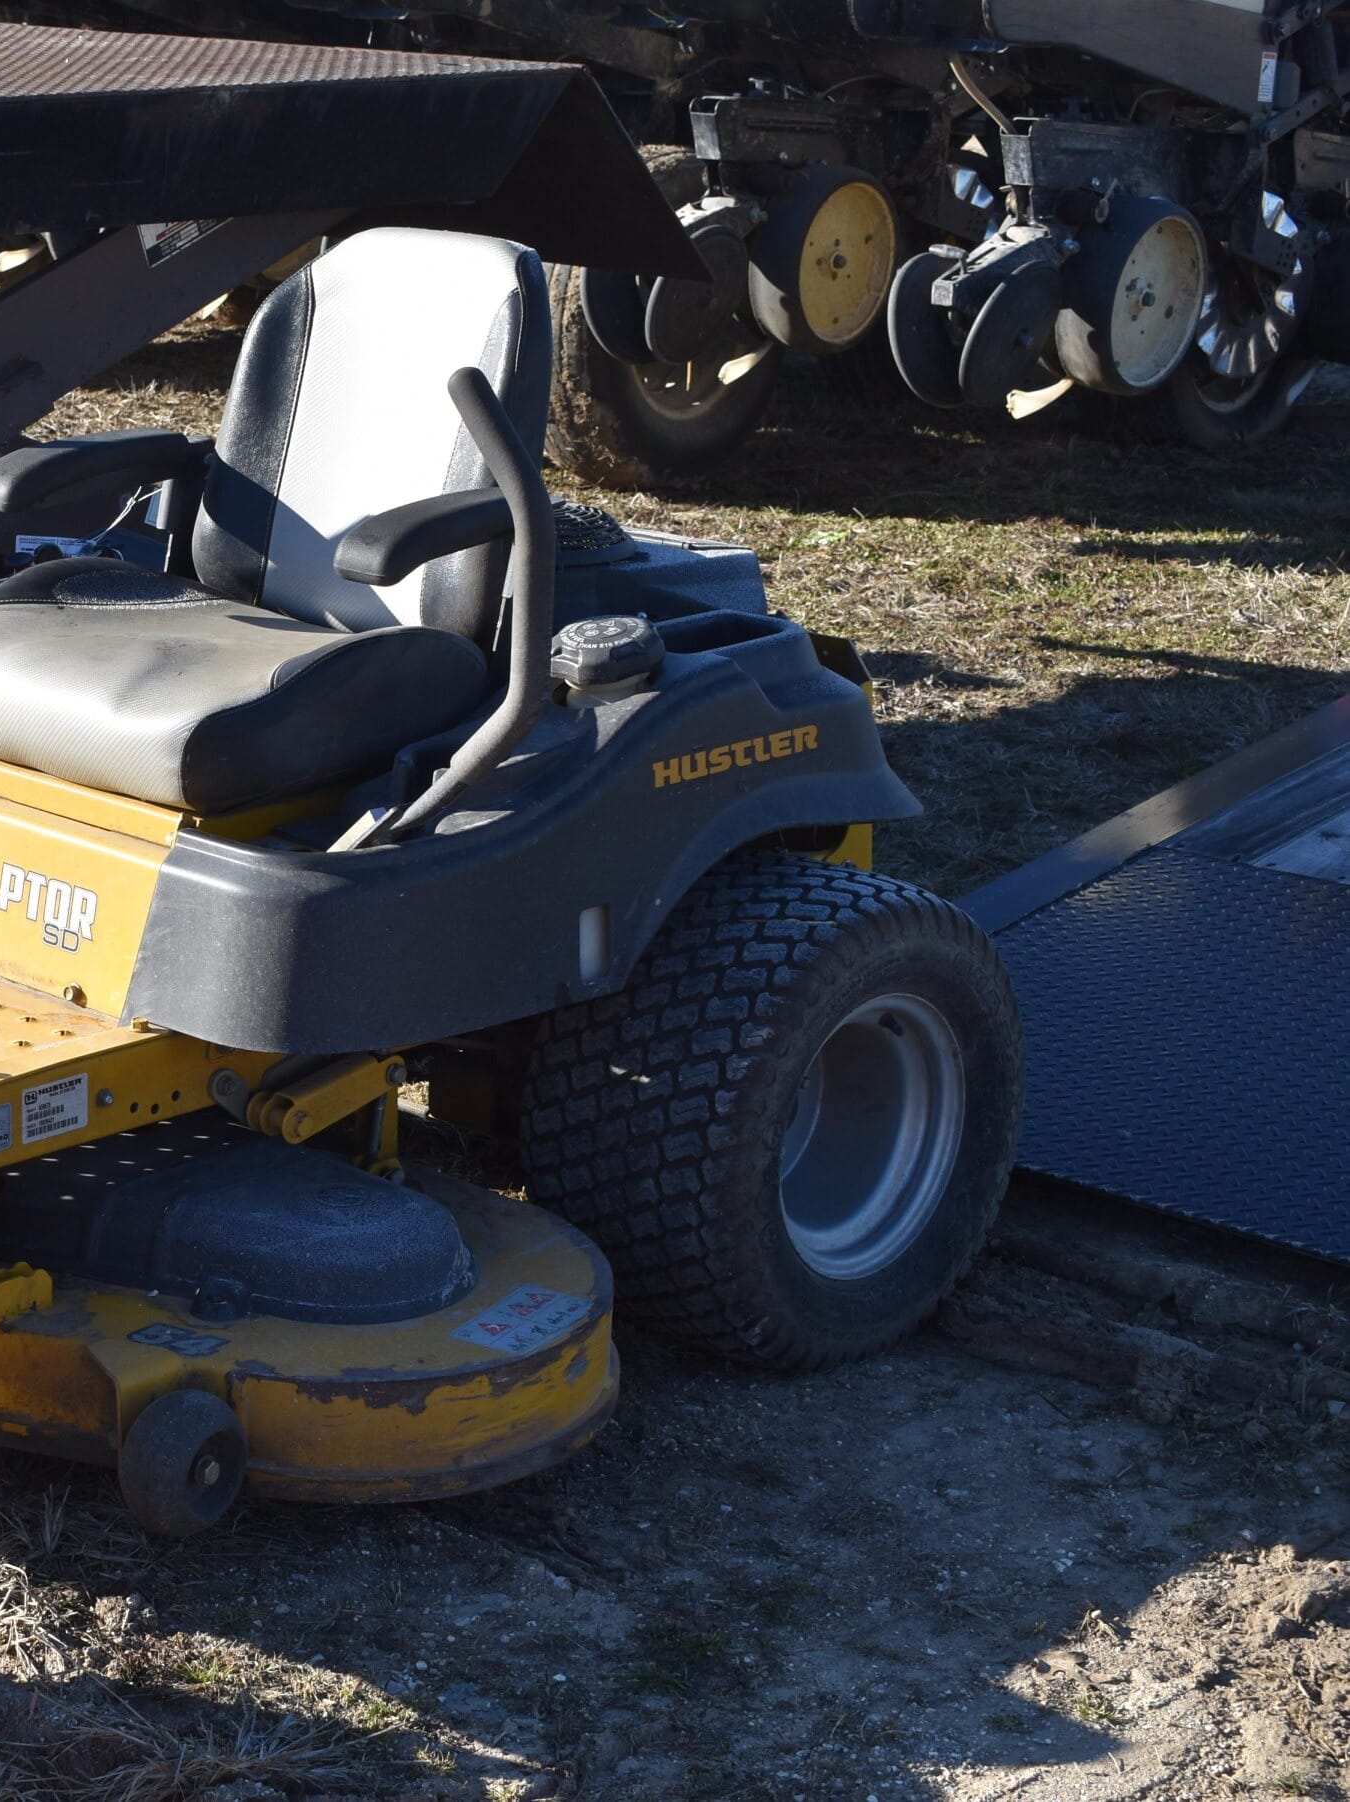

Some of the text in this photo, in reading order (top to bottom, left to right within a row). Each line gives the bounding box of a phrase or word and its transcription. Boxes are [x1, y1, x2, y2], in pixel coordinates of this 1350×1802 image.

[652, 724, 818, 788] HUSTLER
[43, 923, 80, 954] SD
[38, 1079, 82, 1095] HUSTLER
